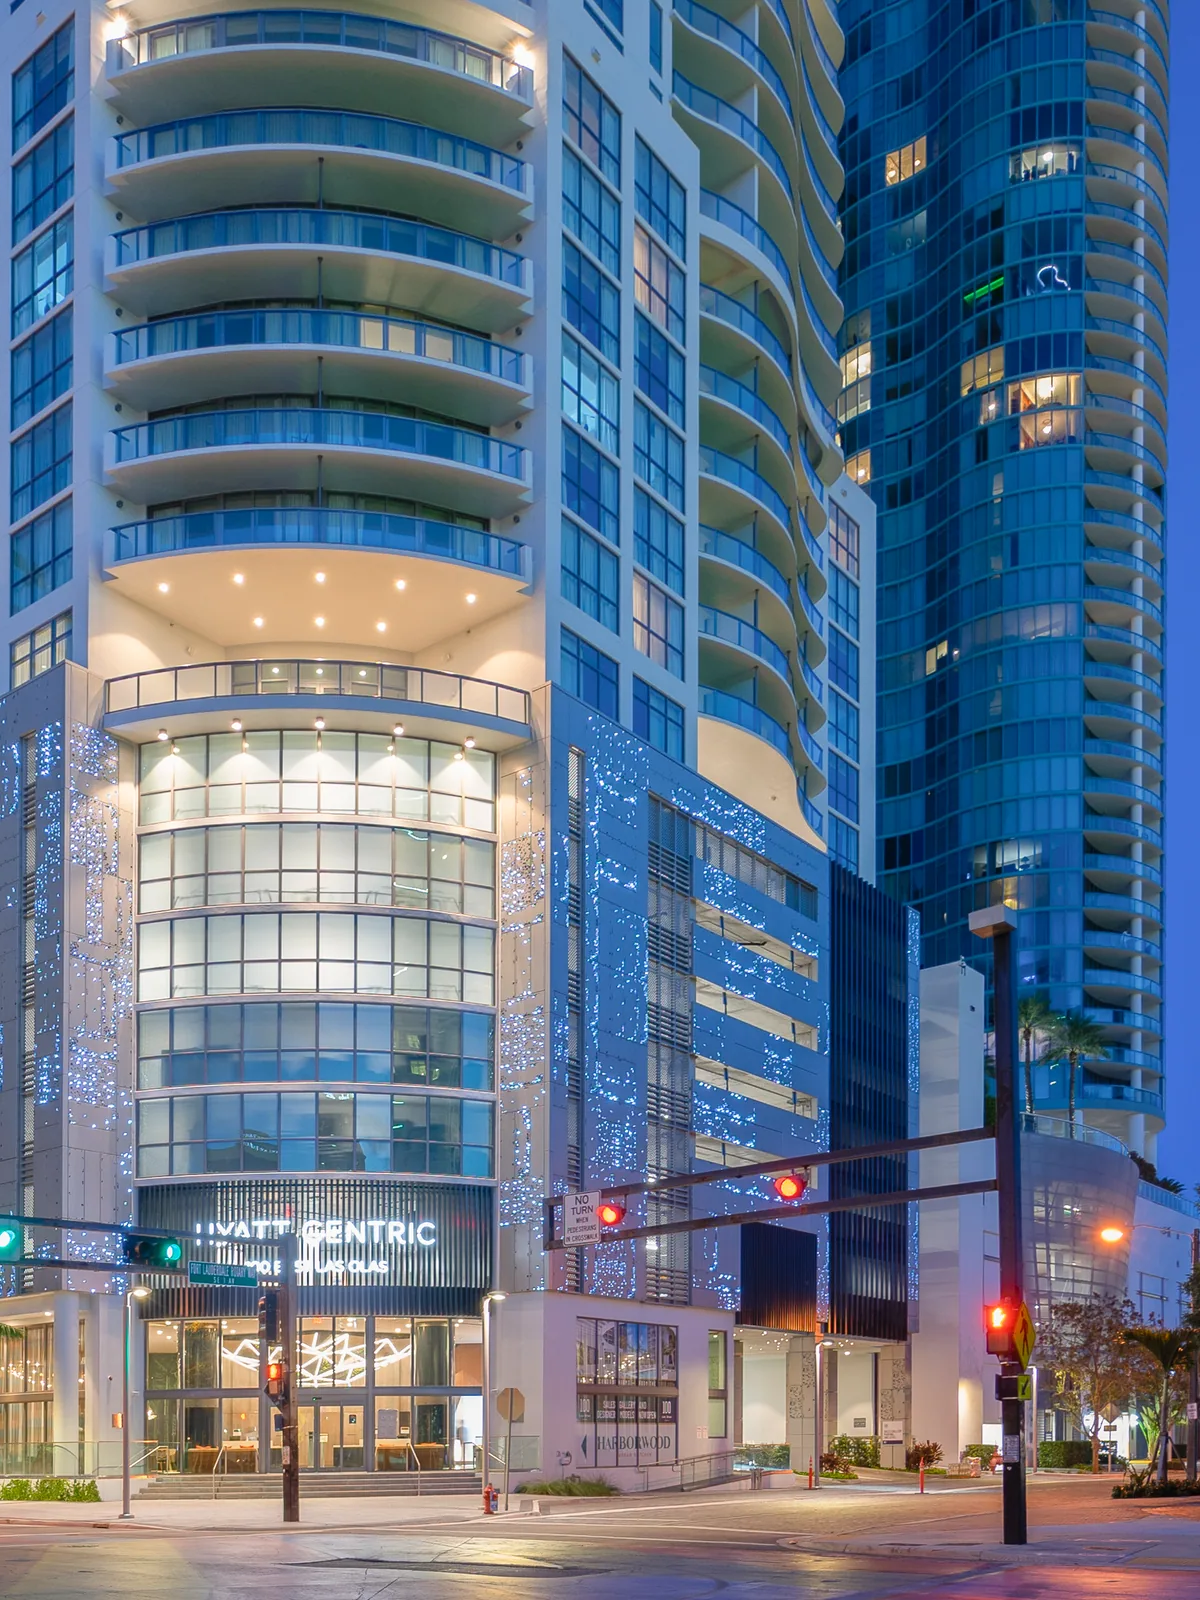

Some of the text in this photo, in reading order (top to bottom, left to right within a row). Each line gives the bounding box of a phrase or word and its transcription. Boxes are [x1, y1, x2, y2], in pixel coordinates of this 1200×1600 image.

[575, 1195, 589, 1205] NO
[571, 1205, 593, 1215] TURN
[302, 1219, 436, 1246] CENTRIC
[572, 1234, 597, 1242] CROSSWALK
[190, 1263, 202, 1275] FORT
[203, 1264, 230, 1277] LAUDERDALE
[347, 1260, 389, 1274] OLAS
[619, 1401, 636, 1409] GALLERY
[662, 1401, 672, 1414] 100
